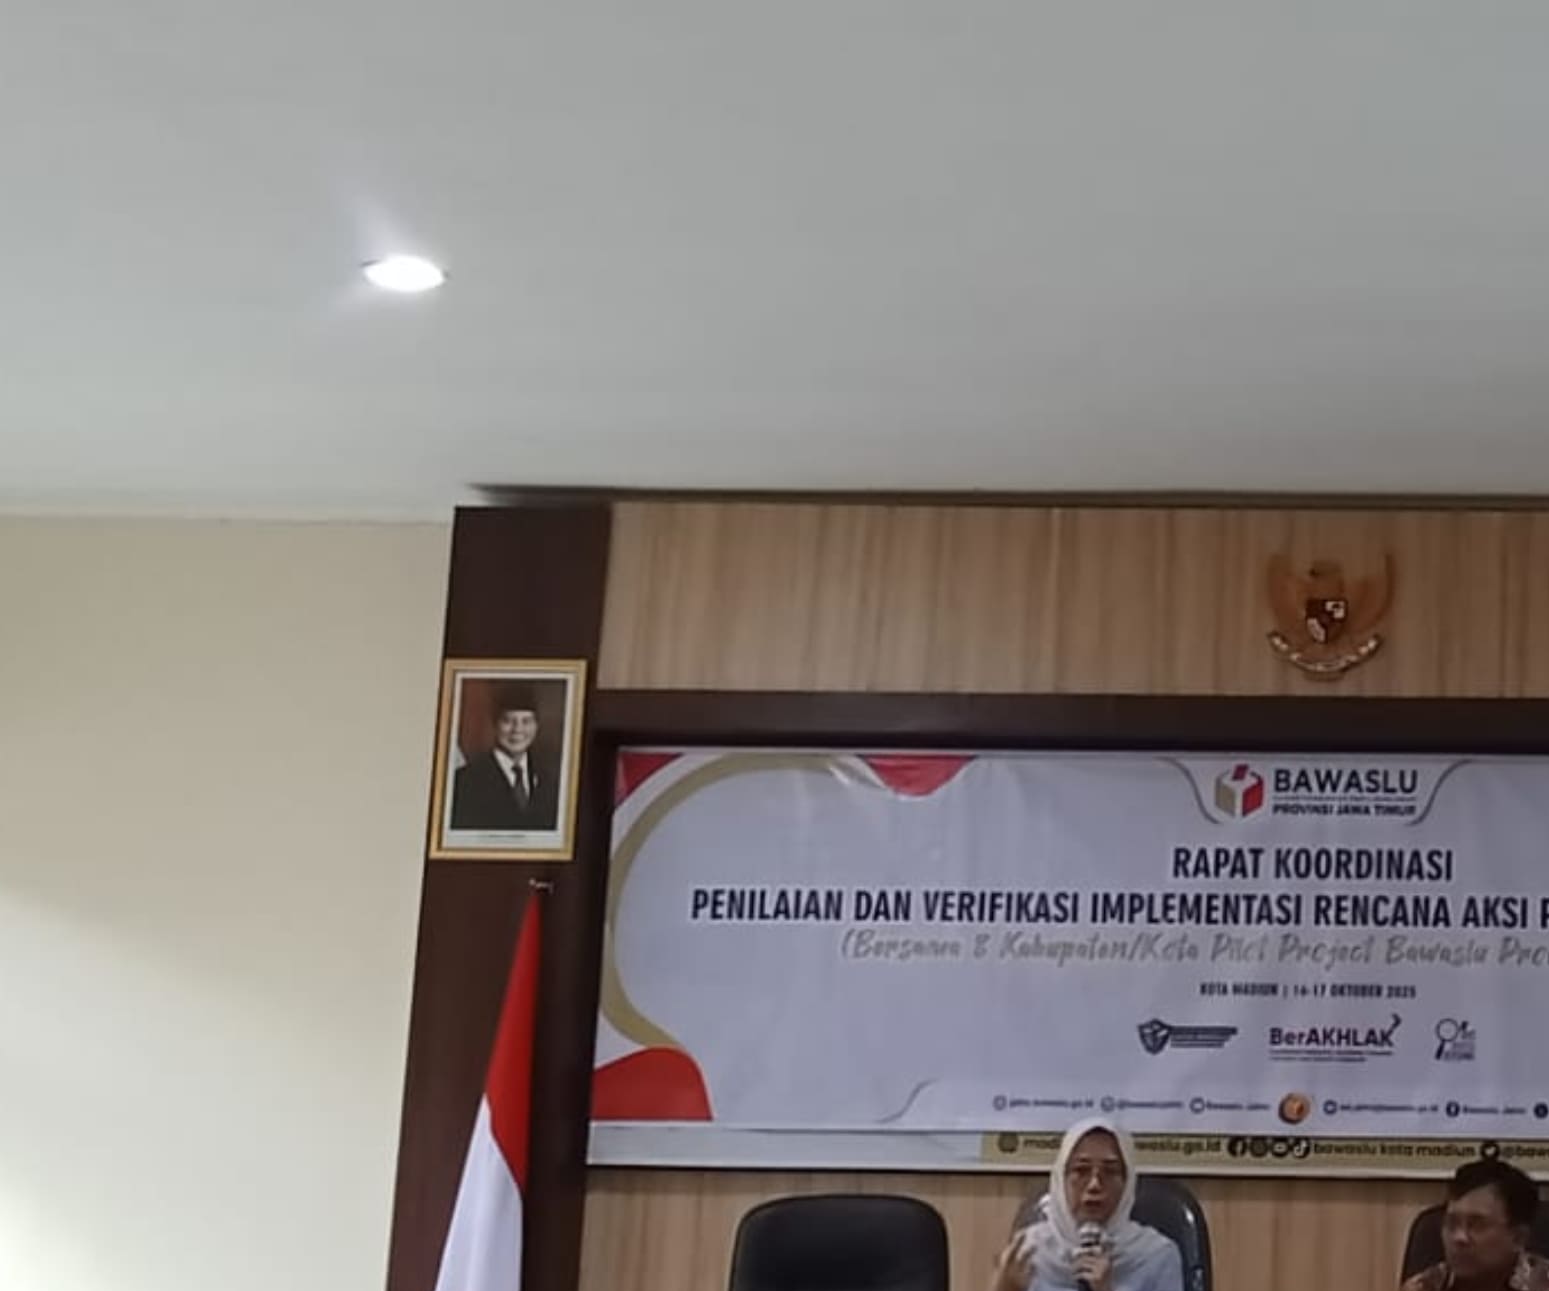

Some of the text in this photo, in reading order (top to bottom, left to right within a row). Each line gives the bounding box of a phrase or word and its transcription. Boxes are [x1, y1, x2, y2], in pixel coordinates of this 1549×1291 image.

[1273, 769, 1418, 793] BAWASLU
[1273, 804, 1416, 816] PROVINSI JAWA TIMUR
[1173, 847, 1453, 881] RAPAT KOORDINASI
[691, 888, 844, 920] PENILAIAN
[853, 890, 912, 922] DAN
[923, 890, 1079, 923] VERIFIKASI
[1090, 892, 1303, 926] IMPLEMENTASI
[1313, 895, 1452, 928] RENCANA
[1461, 897, 1529, 930] AKSI
[1210, 931, 1269, 962] Pilot
[1277, 933, 1375, 971] Project
[1384, 935, 1488, 965] Bawaslu
[1200, 982, 1228, 996] KOTA
[1330, 984, 1382, 998] OKTOBER
[1269, 1021, 1398, 1047] BerAKHLAK
[1313, 1143, 1377, 1156] bawaslu
[1381, 1143, 1413, 1156] kota
[1416, 1145, 1476, 1157] madiun
